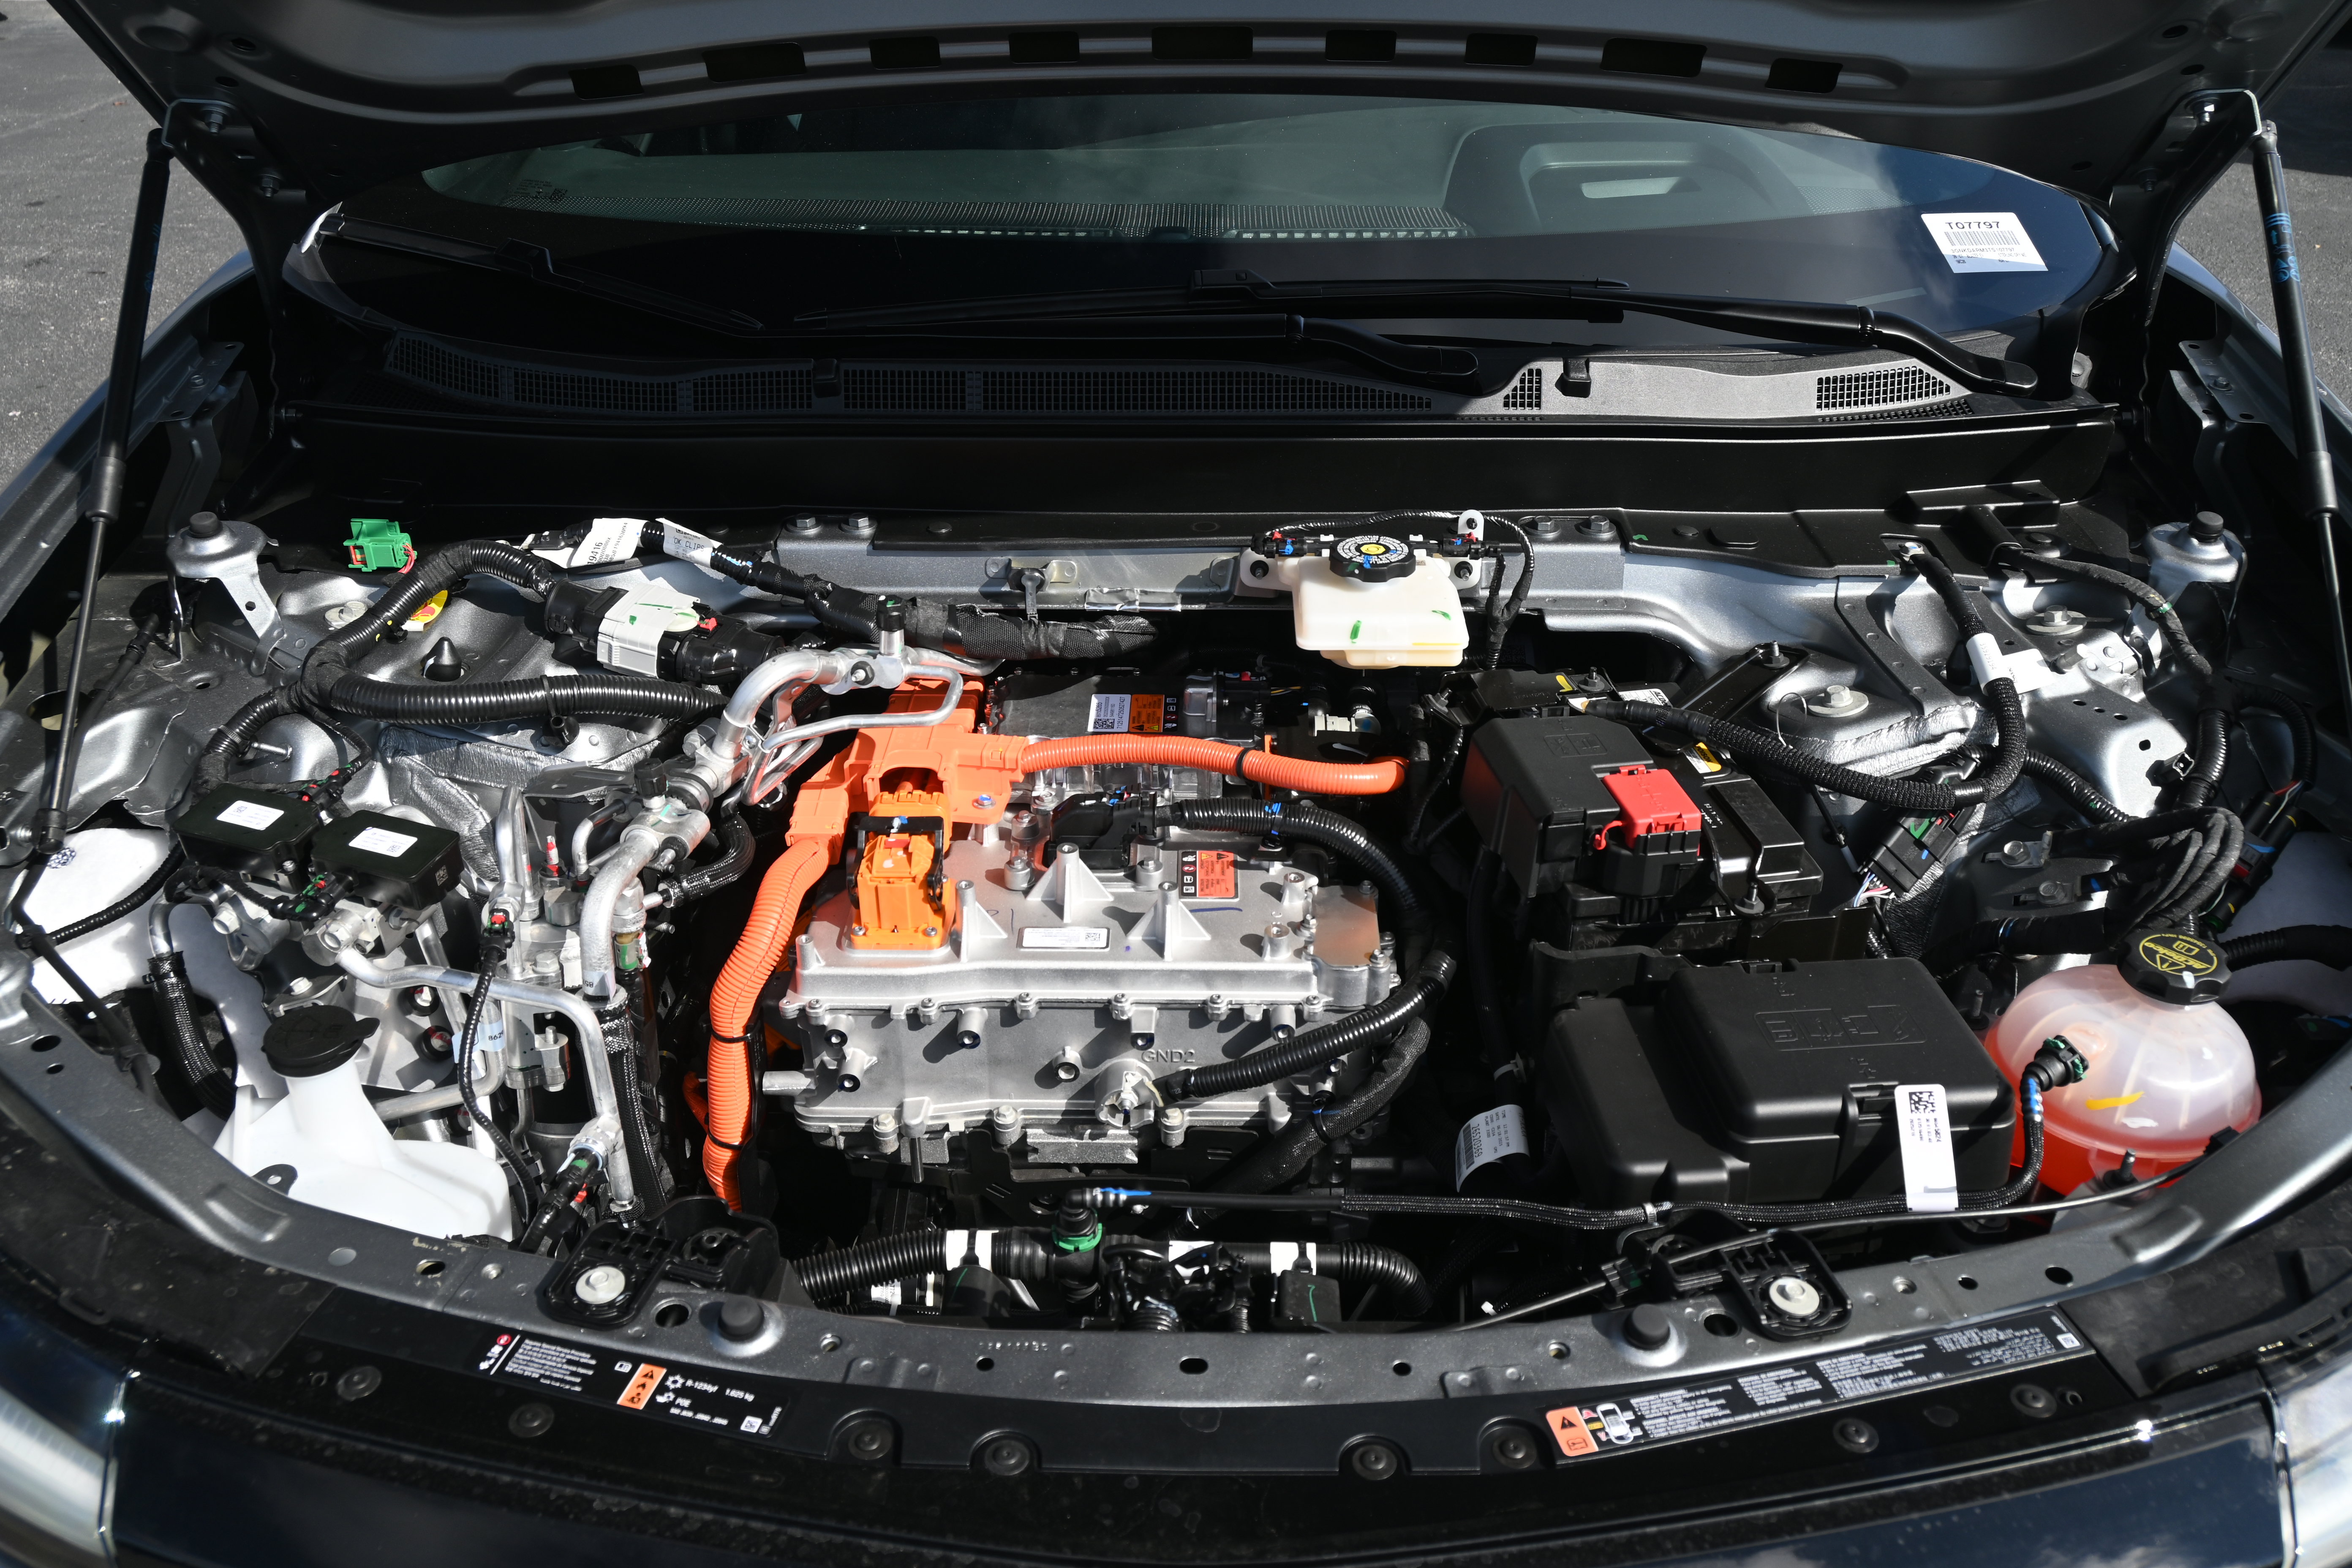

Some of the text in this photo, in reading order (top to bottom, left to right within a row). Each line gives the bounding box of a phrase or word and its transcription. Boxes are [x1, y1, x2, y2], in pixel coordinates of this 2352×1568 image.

[1945, 221, 2000, 230] T07797
[674, 537, 682, 545] OK
[685, 540, 705, 552] CLIPS
[1141, 1049, 1195, 1063] GND2
[1472, 1124, 1483, 1158] 26520369
[685, 1378, 755, 1402] R-1234yf 1.625 kg
[675, 1396, 692, 1407] POE
